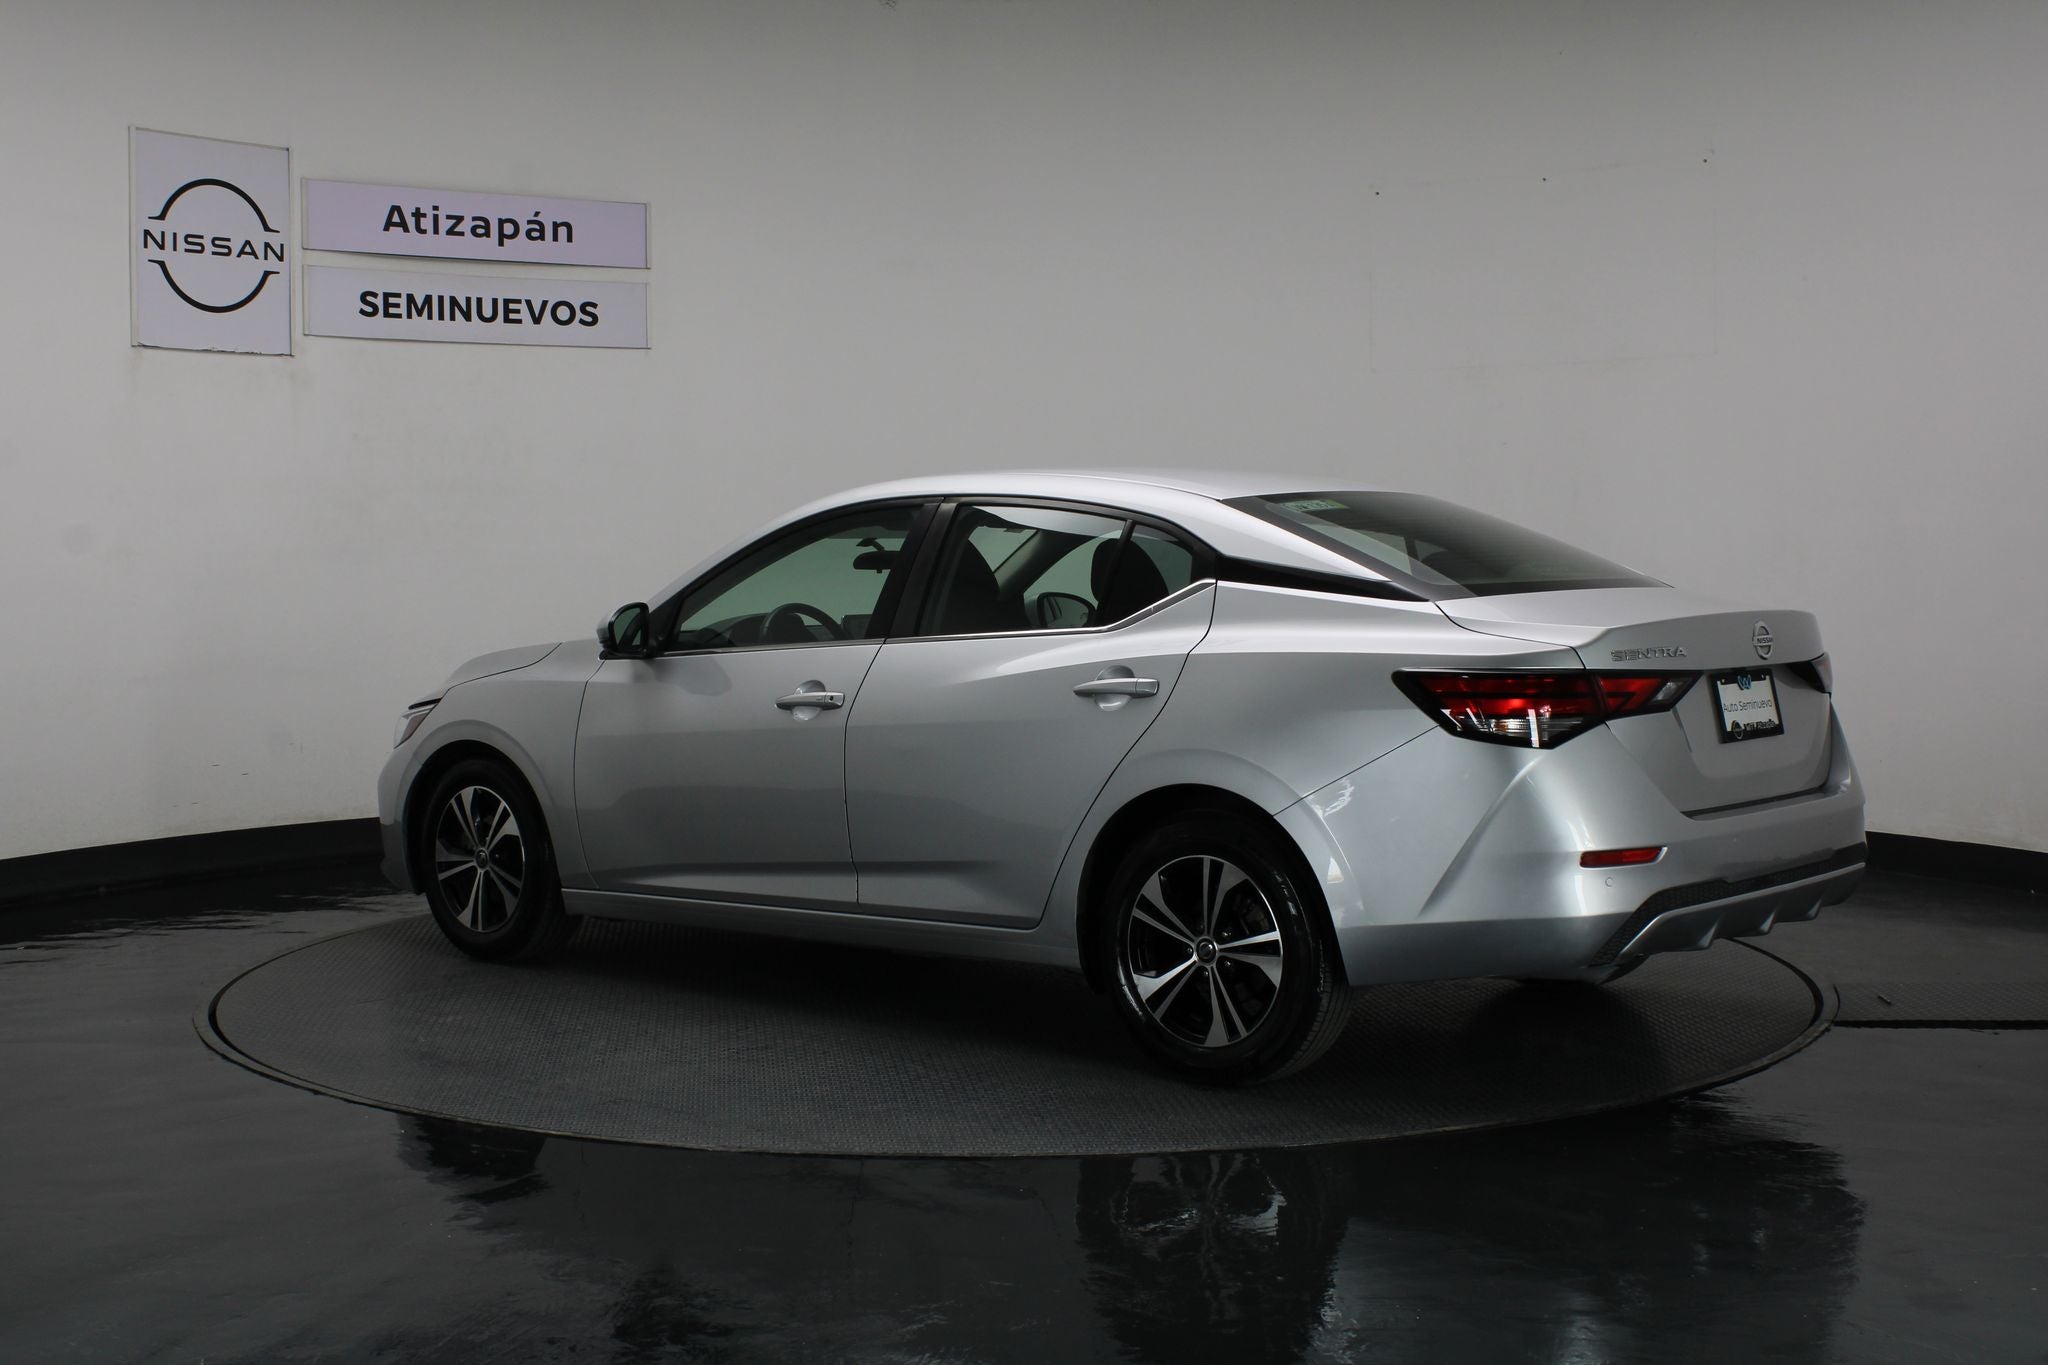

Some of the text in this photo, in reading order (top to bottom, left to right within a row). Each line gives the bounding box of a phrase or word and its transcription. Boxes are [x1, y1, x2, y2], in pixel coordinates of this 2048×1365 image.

[383, 204, 573, 248] Atizapán
[143, 229, 285, 263] NISSAN
[359, 290, 599, 327] SEMINUEVOS
[1610, 646, 1688, 662] SENTRA
